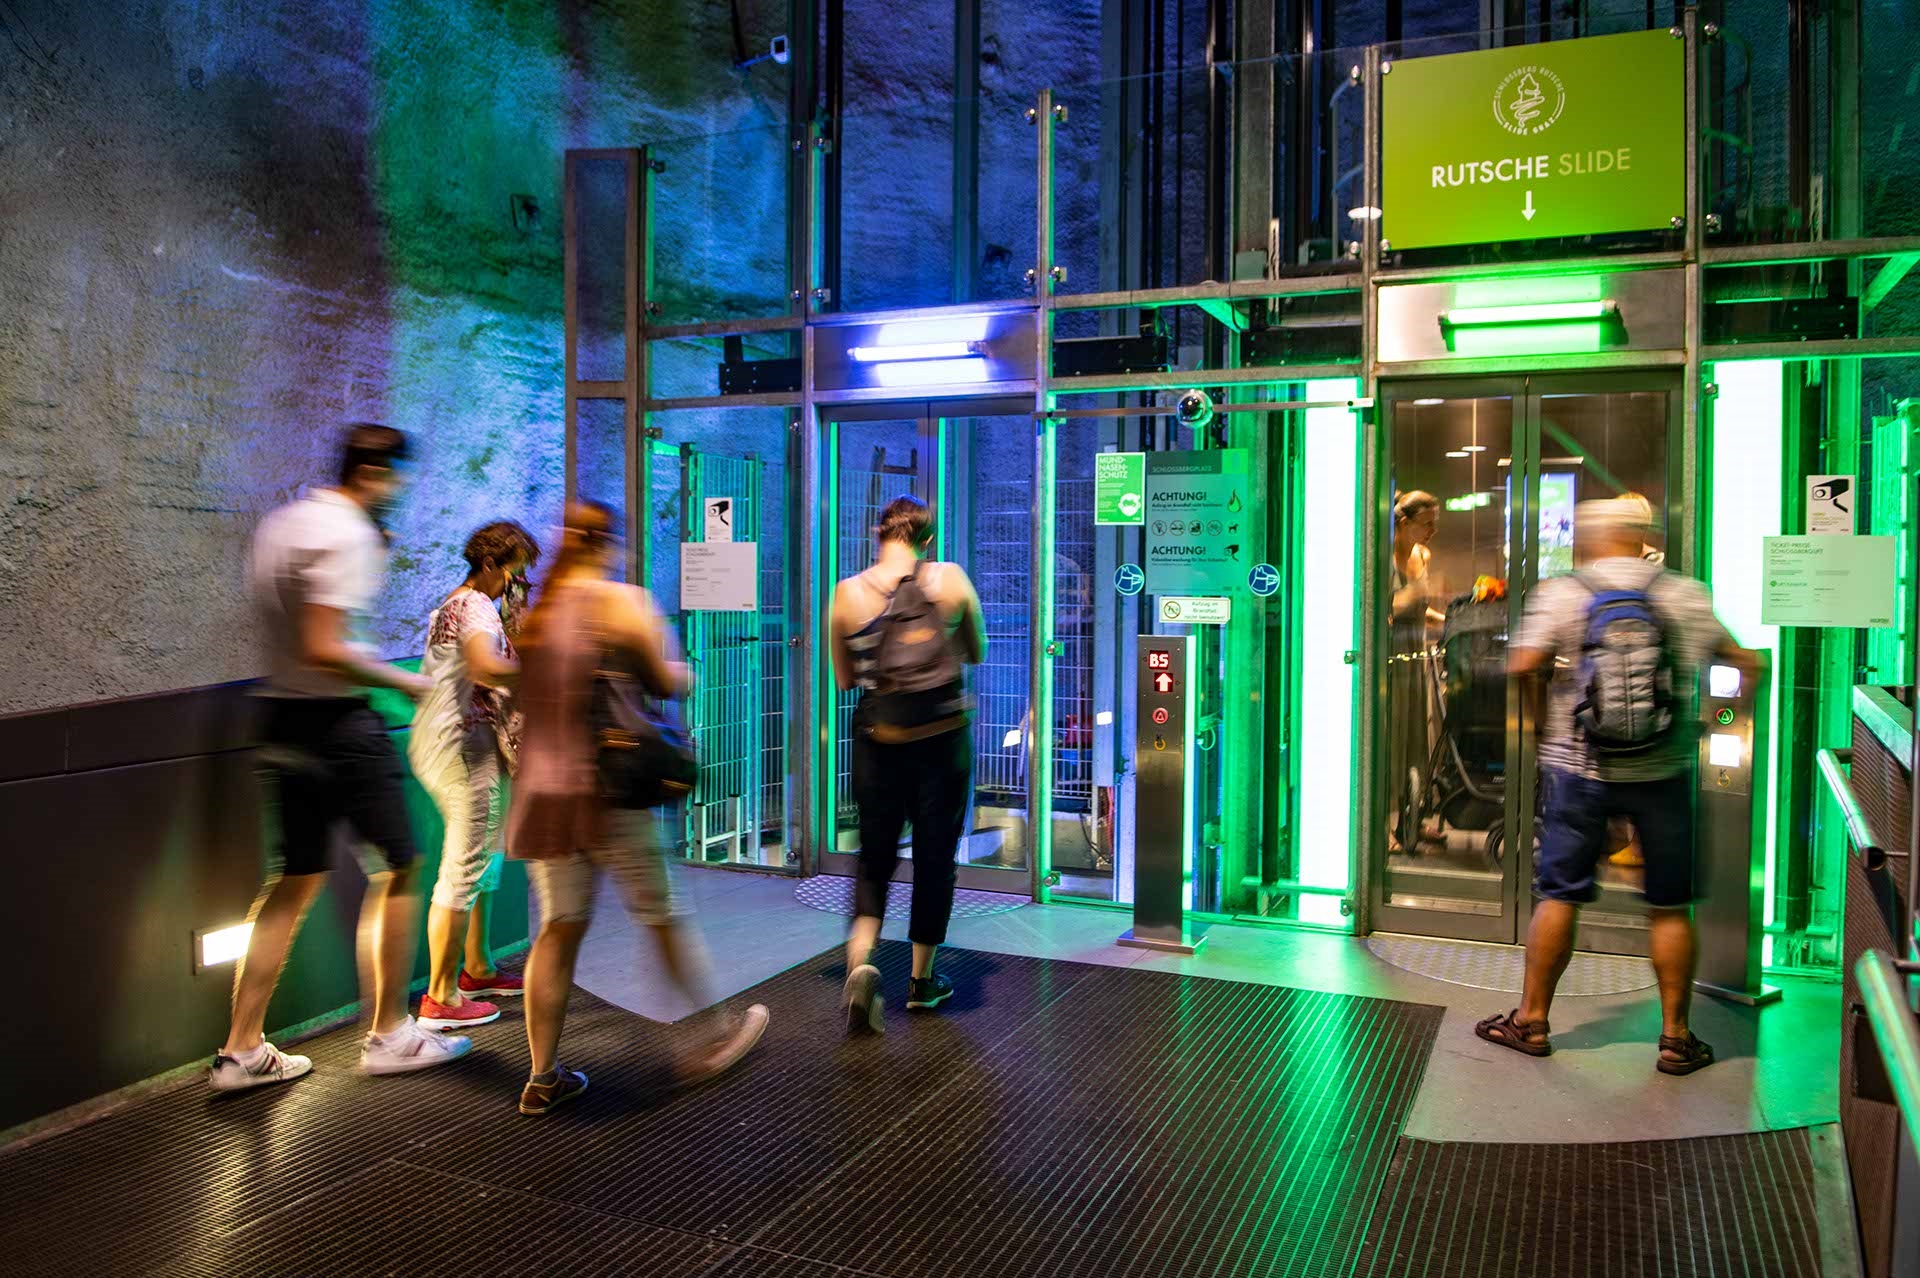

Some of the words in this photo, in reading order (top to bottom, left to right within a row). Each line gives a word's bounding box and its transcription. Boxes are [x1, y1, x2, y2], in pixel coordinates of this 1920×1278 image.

[1503, 121, 1528, 136] SLIDE
[1532, 116, 1557, 134] GRAZ
[1432, 155, 1549, 188] RUTSCHE
[1558, 147, 1631, 176] SLIDE
[1099, 456, 1126, 464] MUND-
[1099, 471, 1128, 479] SCHUTZ
[1152, 491, 1207, 501] ACHTUNG!
[1151, 545, 1206, 555] ACHTUNG!
[1719, 768, 1727, 777] K
